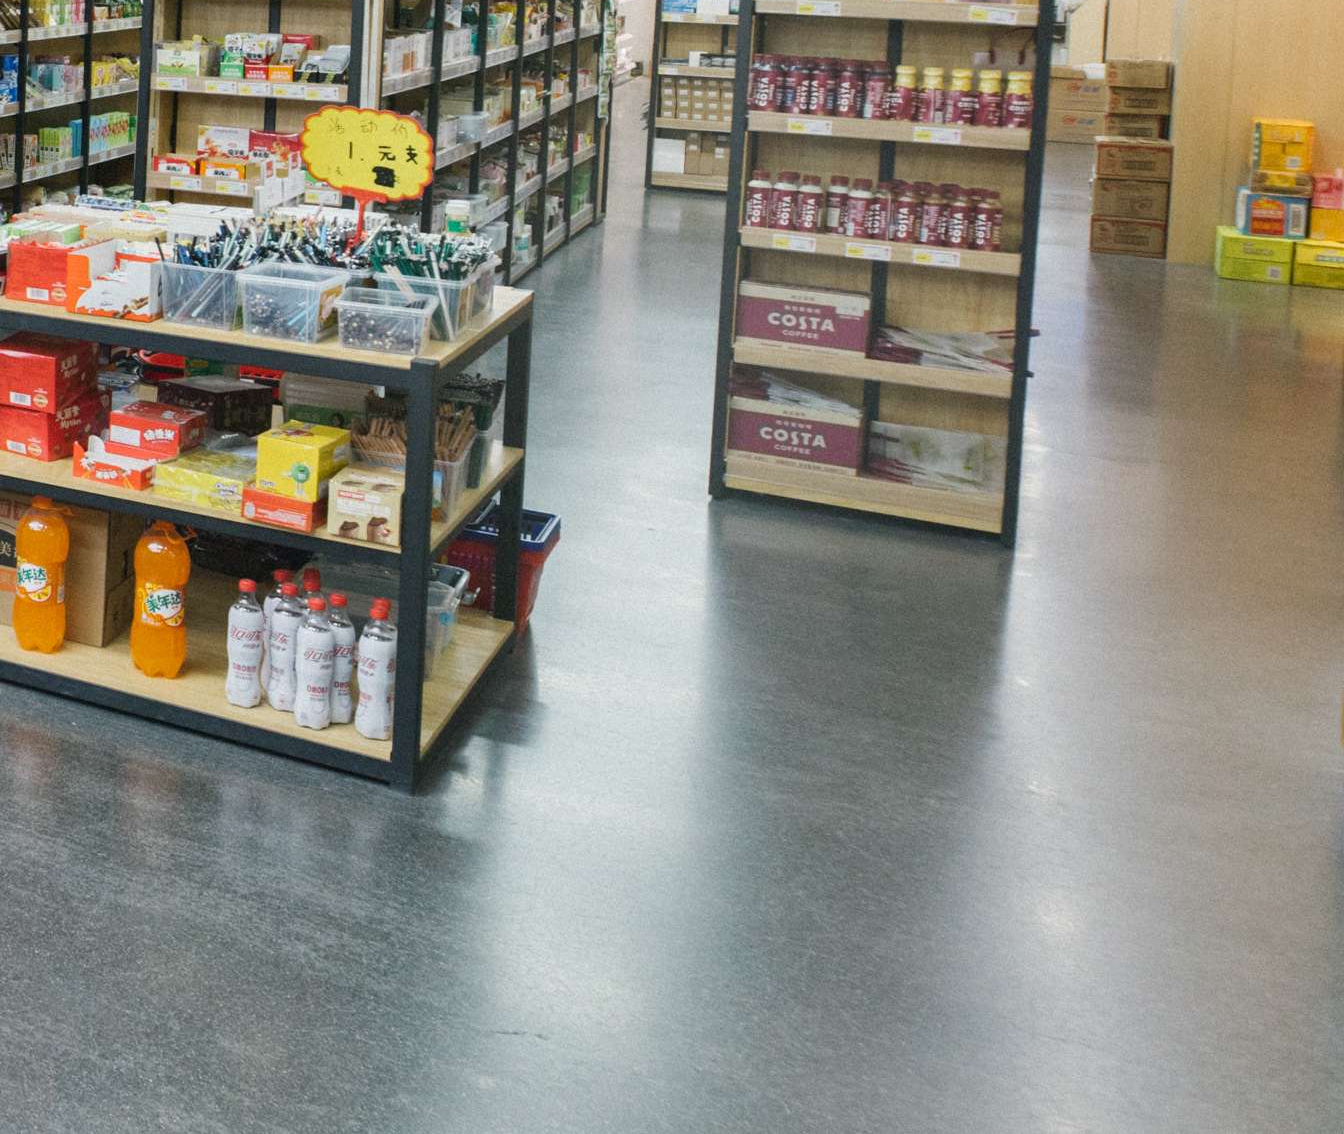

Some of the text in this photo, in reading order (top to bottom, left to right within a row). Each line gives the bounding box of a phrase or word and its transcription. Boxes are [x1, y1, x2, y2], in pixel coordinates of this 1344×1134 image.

[767, 312, 836, 333] COSTA
[782, 329, 820, 340] COFFEE
[759, 427, 827, 449] COSTA
[774, 444, 811, 455] COFFEE
[146, 591, 182, 613] 美年达
